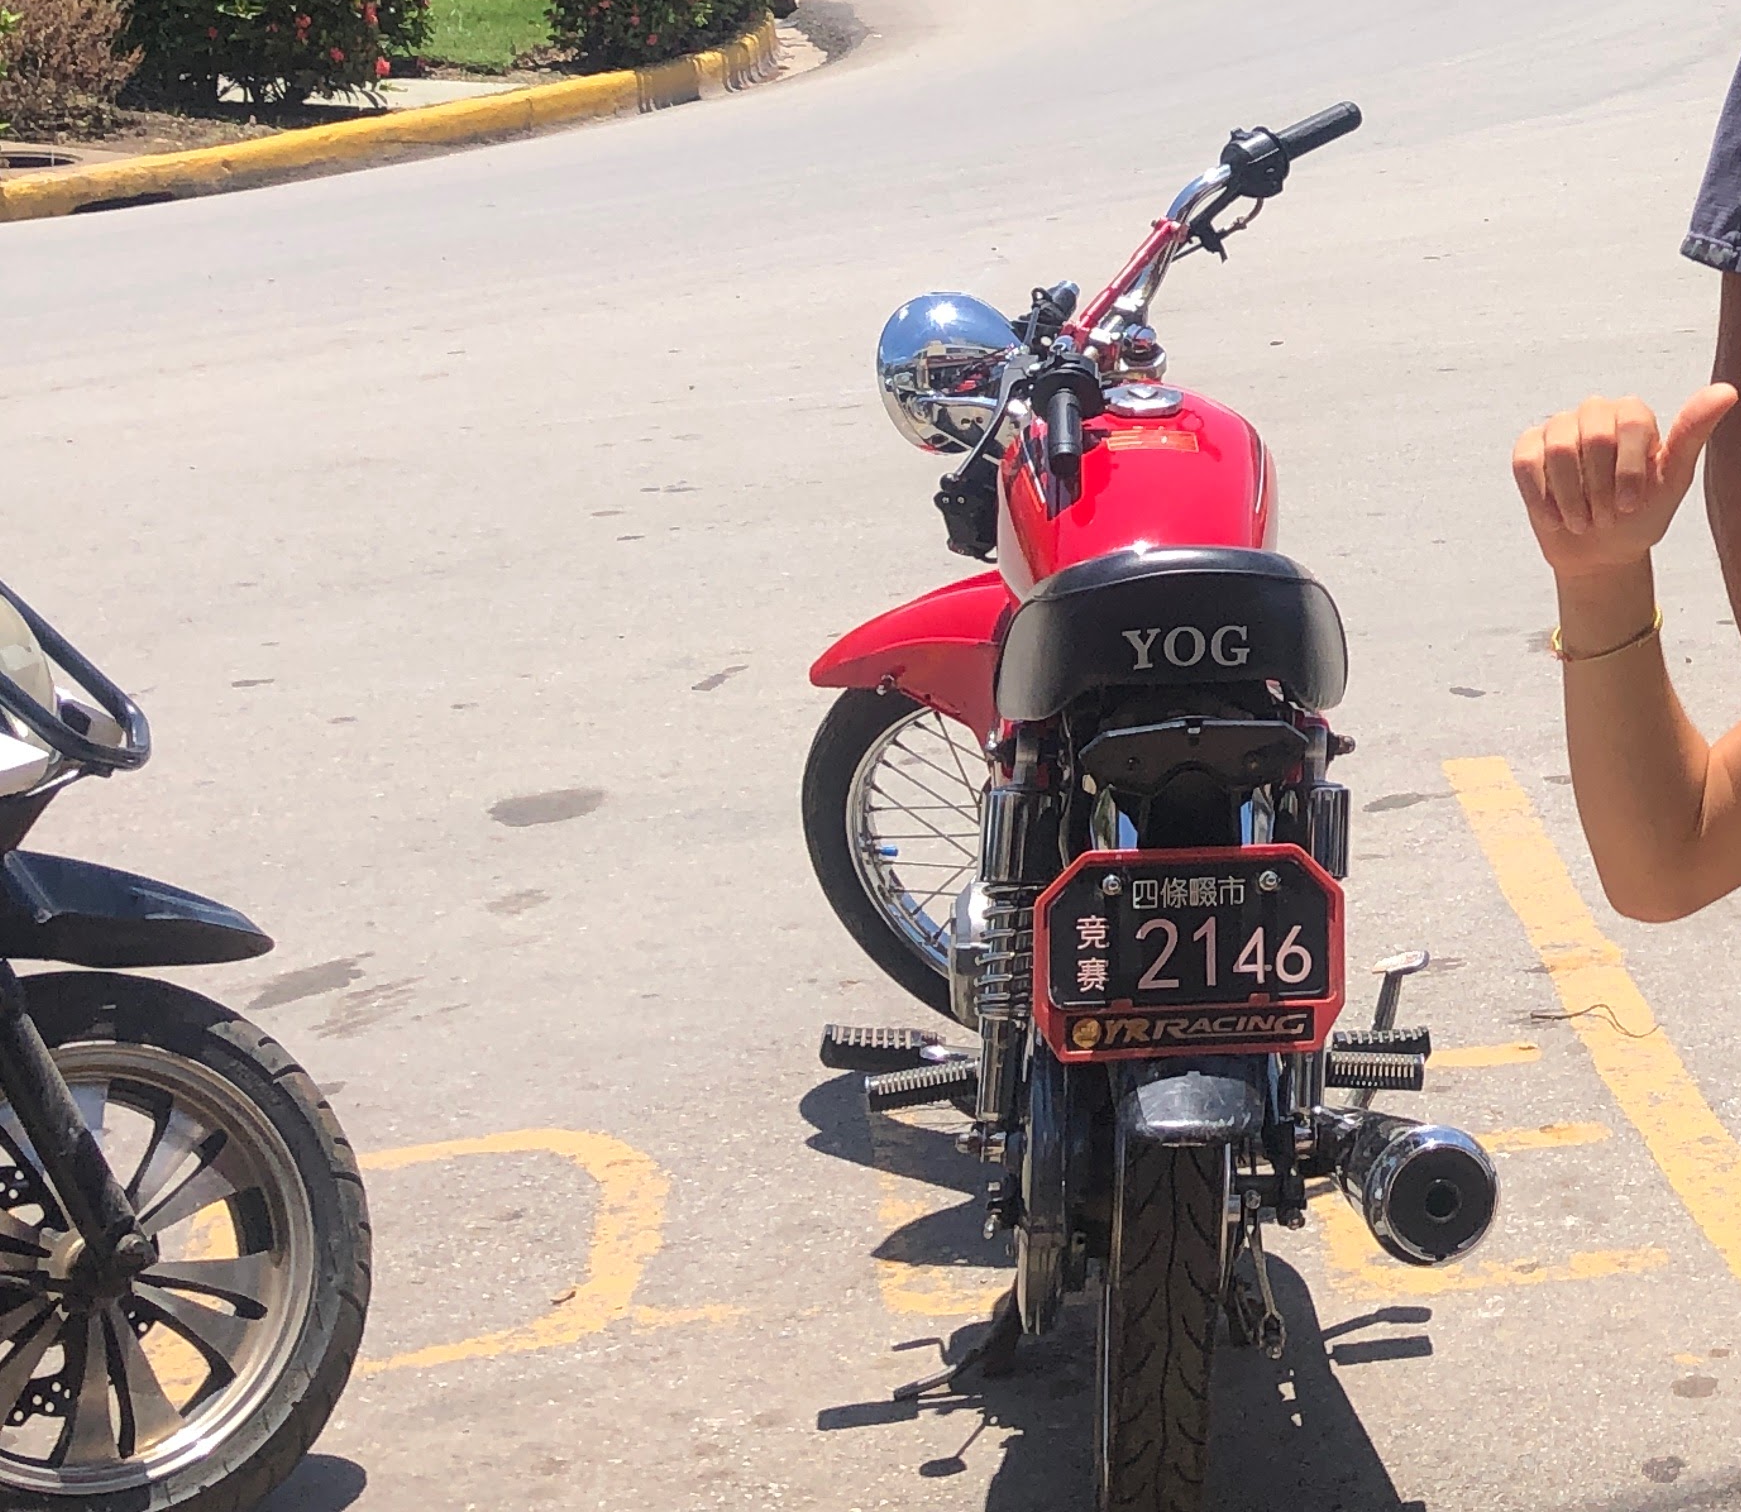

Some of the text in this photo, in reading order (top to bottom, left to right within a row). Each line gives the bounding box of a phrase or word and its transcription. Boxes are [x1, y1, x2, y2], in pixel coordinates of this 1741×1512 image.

[1122, 625, 1251, 670] YOG
[1135, 916, 1313, 990] 2146
[1153, 1013, 1308, 1040] RACING
